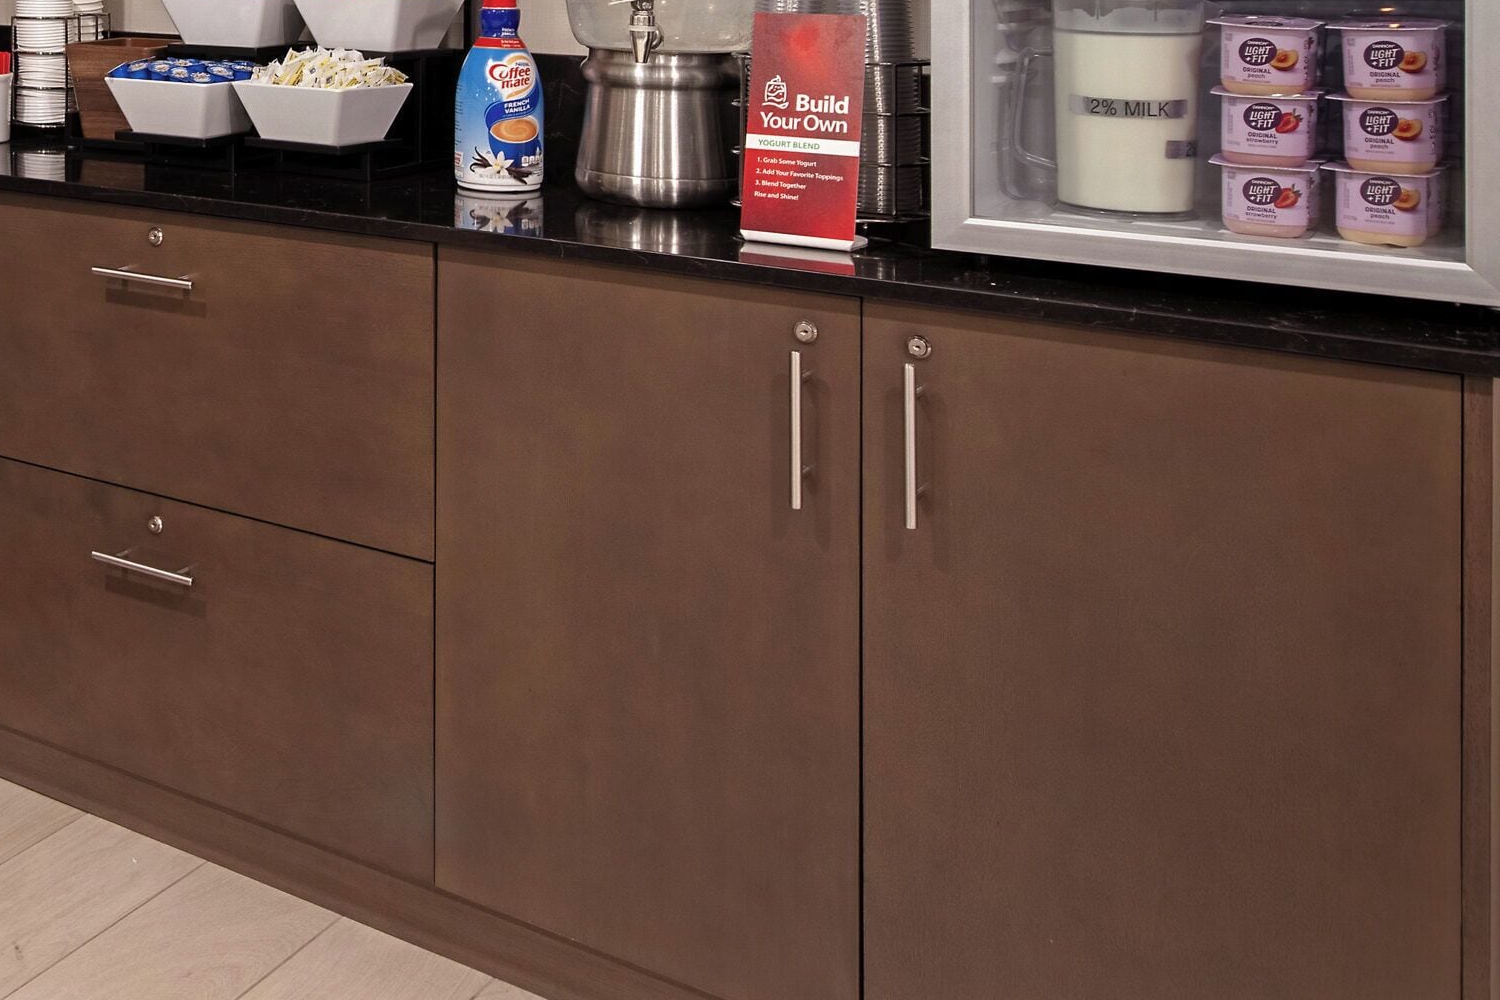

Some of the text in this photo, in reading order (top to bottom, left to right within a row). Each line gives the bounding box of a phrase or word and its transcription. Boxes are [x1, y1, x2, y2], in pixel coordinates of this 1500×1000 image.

[1245, 46, 1273, 56] LIGHT
[1370, 48, 1400, 60] LIGHT
[489, 64, 531, 81] Coffee
[501, 78, 530, 89] mate
[504, 98, 530, 108] FRENCH
[796, 94, 850, 114] Build
[1090, 99, 1170, 117] 2% MILK
[504, 104, 531, 114] VANILLA
[1249, 110, 1280, 120] LIGHT
[760, 111, 848, 133] Your Own
[1365, 115, 1394, 126] LIGHT
[1248, 131, 1277, 139] ORIGINAL
[759, 139, 820, 150] YOGURT BLEND
[815, 173, 844, 182] Toppings
[1249, 185, 1279, 195] LIGHT
[1366, 185, 1397, 195] LIGHT
[1246, 206, 1276, 214] ORIGINAL
[1365, 207, 1396, 215] ORIGINAL
